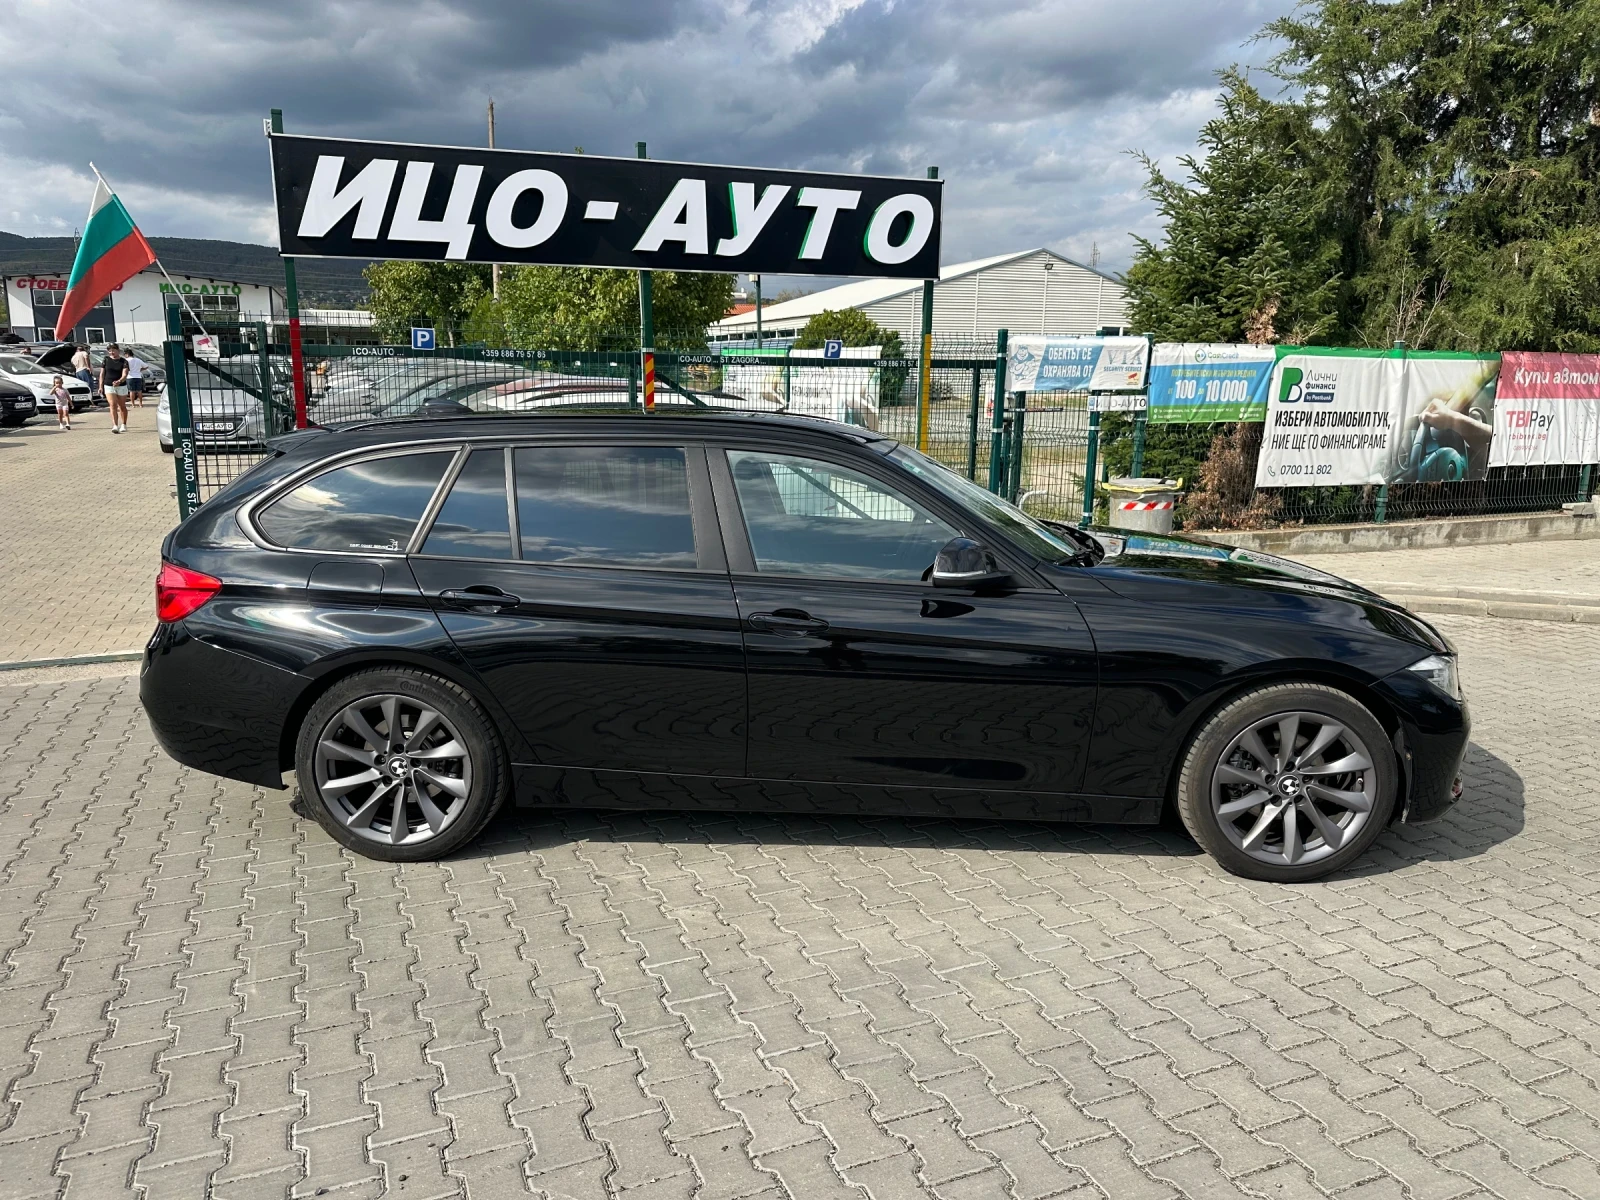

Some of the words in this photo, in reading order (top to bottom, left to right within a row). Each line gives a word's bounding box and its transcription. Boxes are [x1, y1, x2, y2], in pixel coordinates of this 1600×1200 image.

[481, 349, 499, 358] +359
[1048, 347, 1081, 361] ОБЕКТЪТ
[1081, 347, 1094, 360] СЕ
[1043, 365, 1081, 378] ОХРАНЯВА
[1082, 365, 1094, 378] ОТ
[1306, 369, 1338, 382] Лични
[1514, 367, 1550, 388] Купи
[1552, 367, 1600, 385] автом
[1175, 379, 1197, 400] 100
[1274, 410, 1313, 427] ИЗБЕРИ
[1313, 411, 1372, 428] АВТОМОБИЛ
[1371, 411, 1391, 430] ТУК,
[1271, 434, 1291, 449] НИЕ
[1291, 434, 1307, 452] ЩЕ
[1307, 434, 1319, 449] ГО
[1320, 433, 1387, 449] ФИНАНСИРАМЕ
[181, 439, 195, 481] iCO-AUTO
[1280, 464, 1303, 475] 0700
[1304, 465, 1315, 475] 11
[1316, 464, 1332, 475] 802
